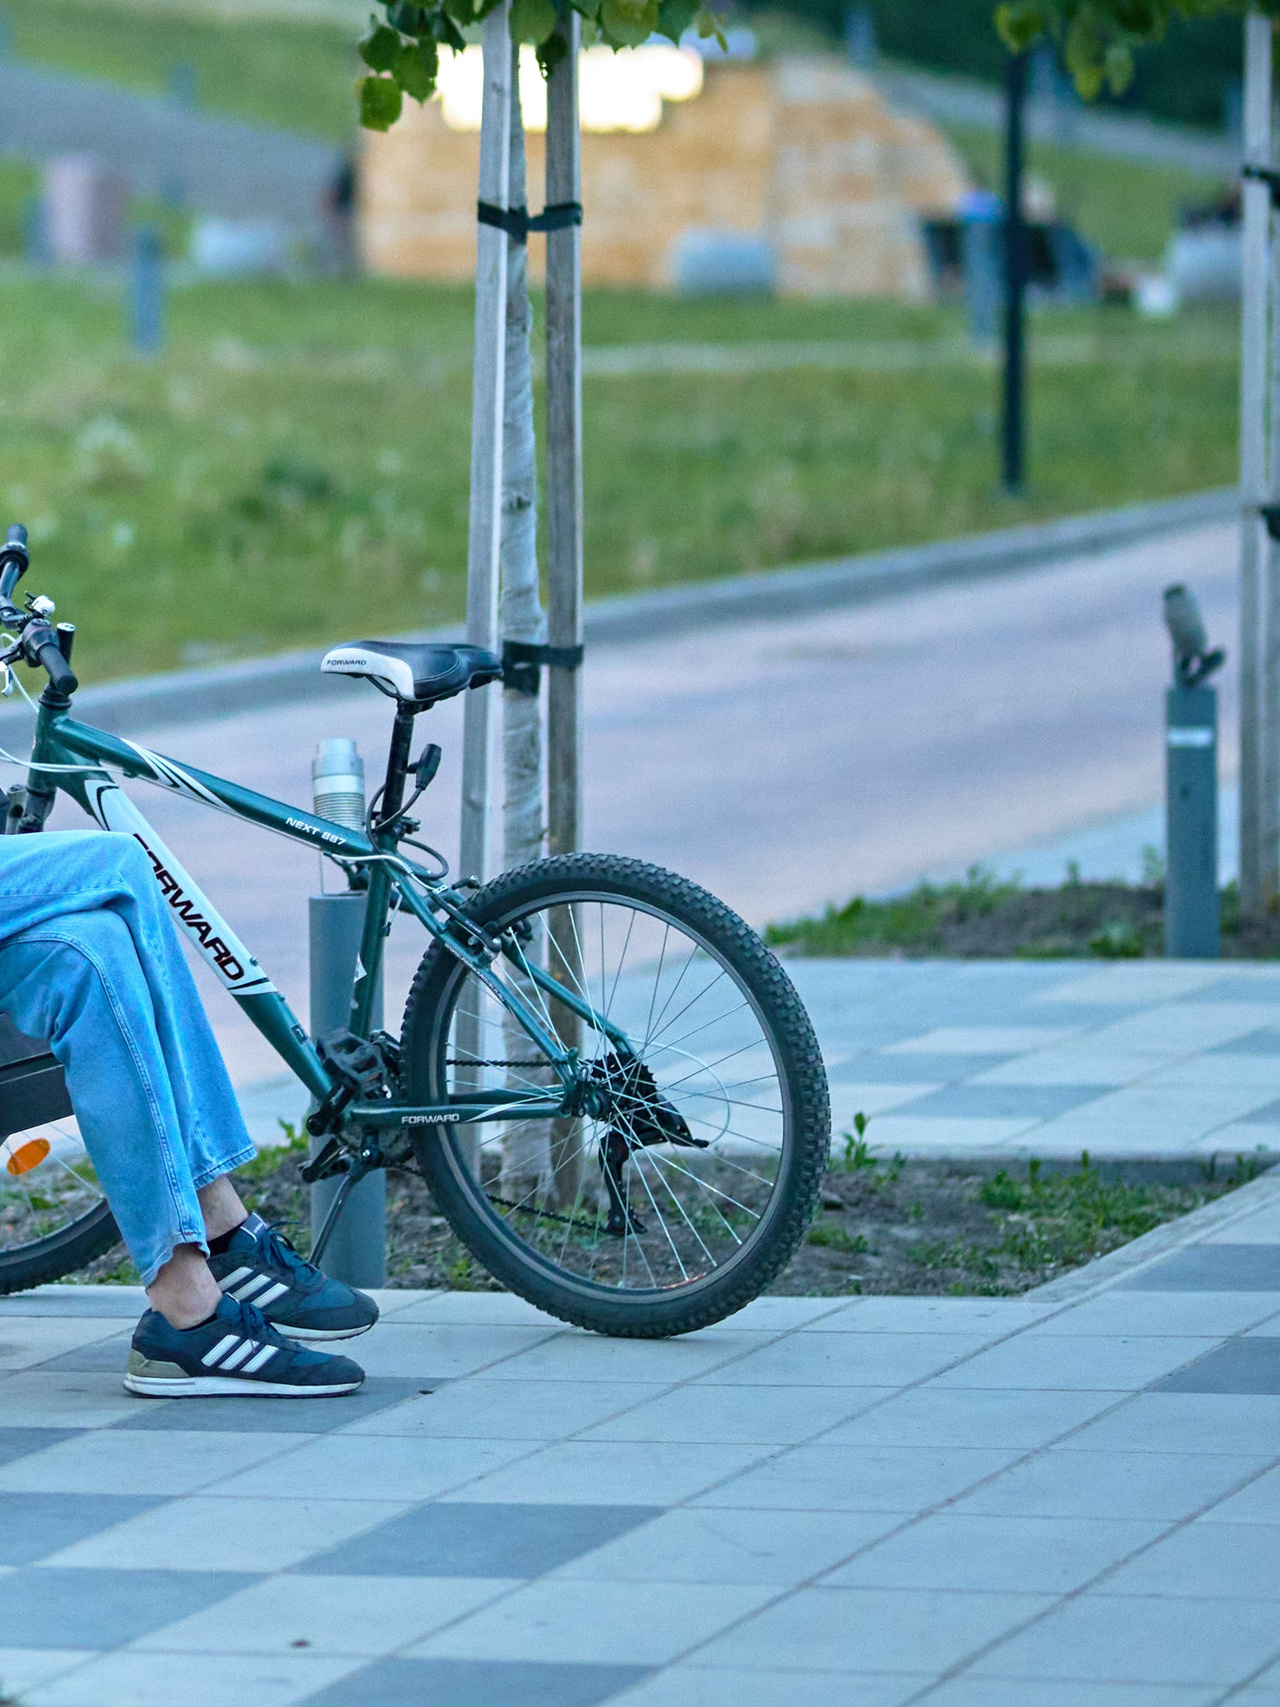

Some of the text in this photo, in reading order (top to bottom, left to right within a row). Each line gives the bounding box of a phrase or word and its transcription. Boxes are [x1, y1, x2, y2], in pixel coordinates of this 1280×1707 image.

[285, 817, 346, 846] NEXT 887
[133, 833, 245, 981] RWARD
[401, 1113, 460, 1125] FORWARD
